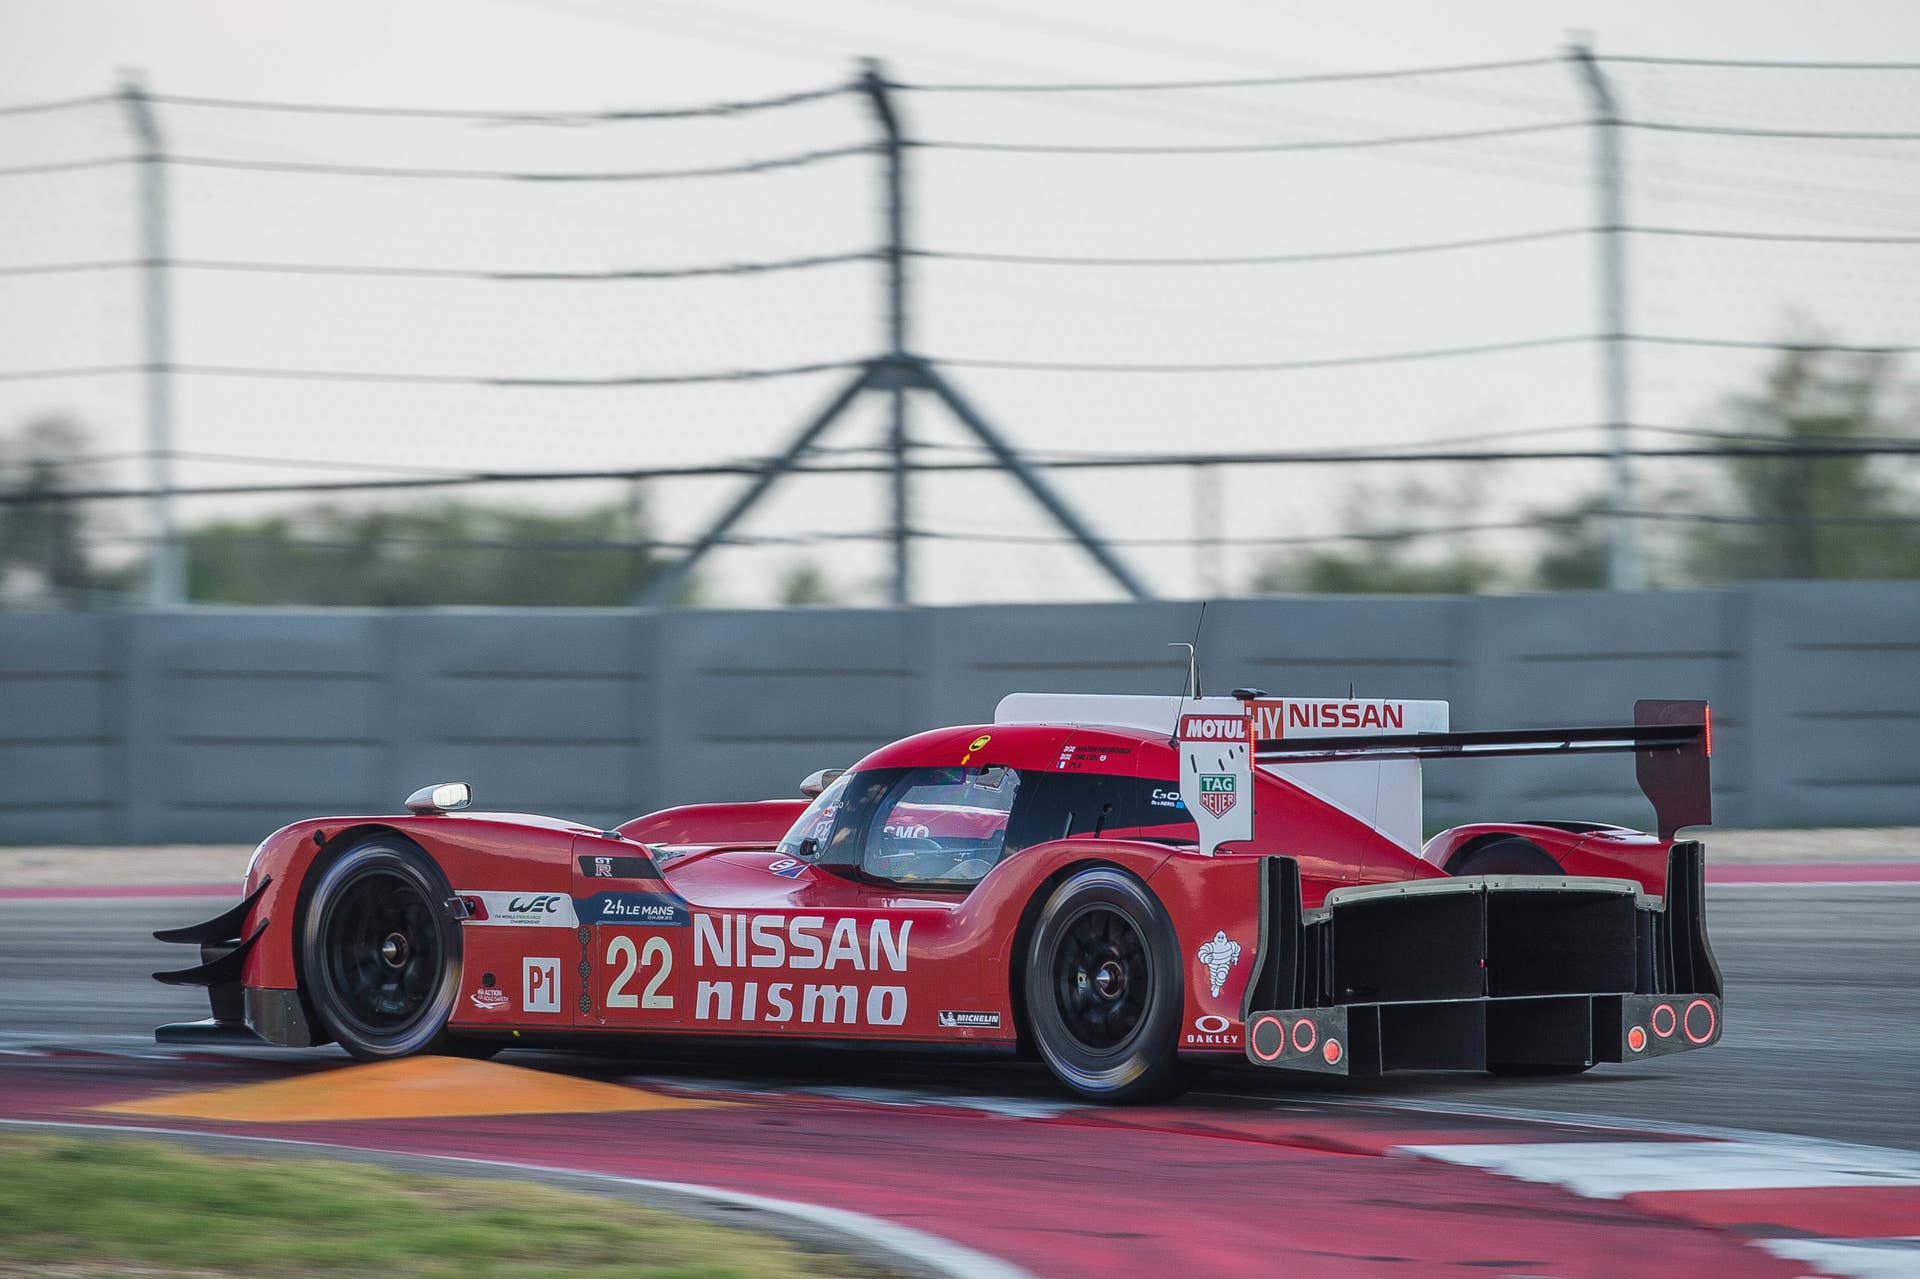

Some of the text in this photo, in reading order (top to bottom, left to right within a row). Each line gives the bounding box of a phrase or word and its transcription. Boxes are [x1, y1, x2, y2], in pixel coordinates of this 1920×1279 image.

[1289, 703, 1403, 729] NISSAN
[1185, 718, 1246, 739] MOTUL
[1203, 776, 1234, 792] TAG
[1202, 793, 1235, 813] HEUER
[595, 864, 613, 877] R
[508, 895, 561, 913] WEC
[626, 905, 641, 915] LE
[641, 905, 675, 916] MANS
[693, 913, 914, 972] NISSAN
[605, 935, 675, 1009] 22
[529, 964, 556, 1005] P1
[695, 980, 908, 1026] nismo
[957, 1014, 999, 1022] MICHELIN
[1187, 1034, 1238, 1044] OAKLEY
